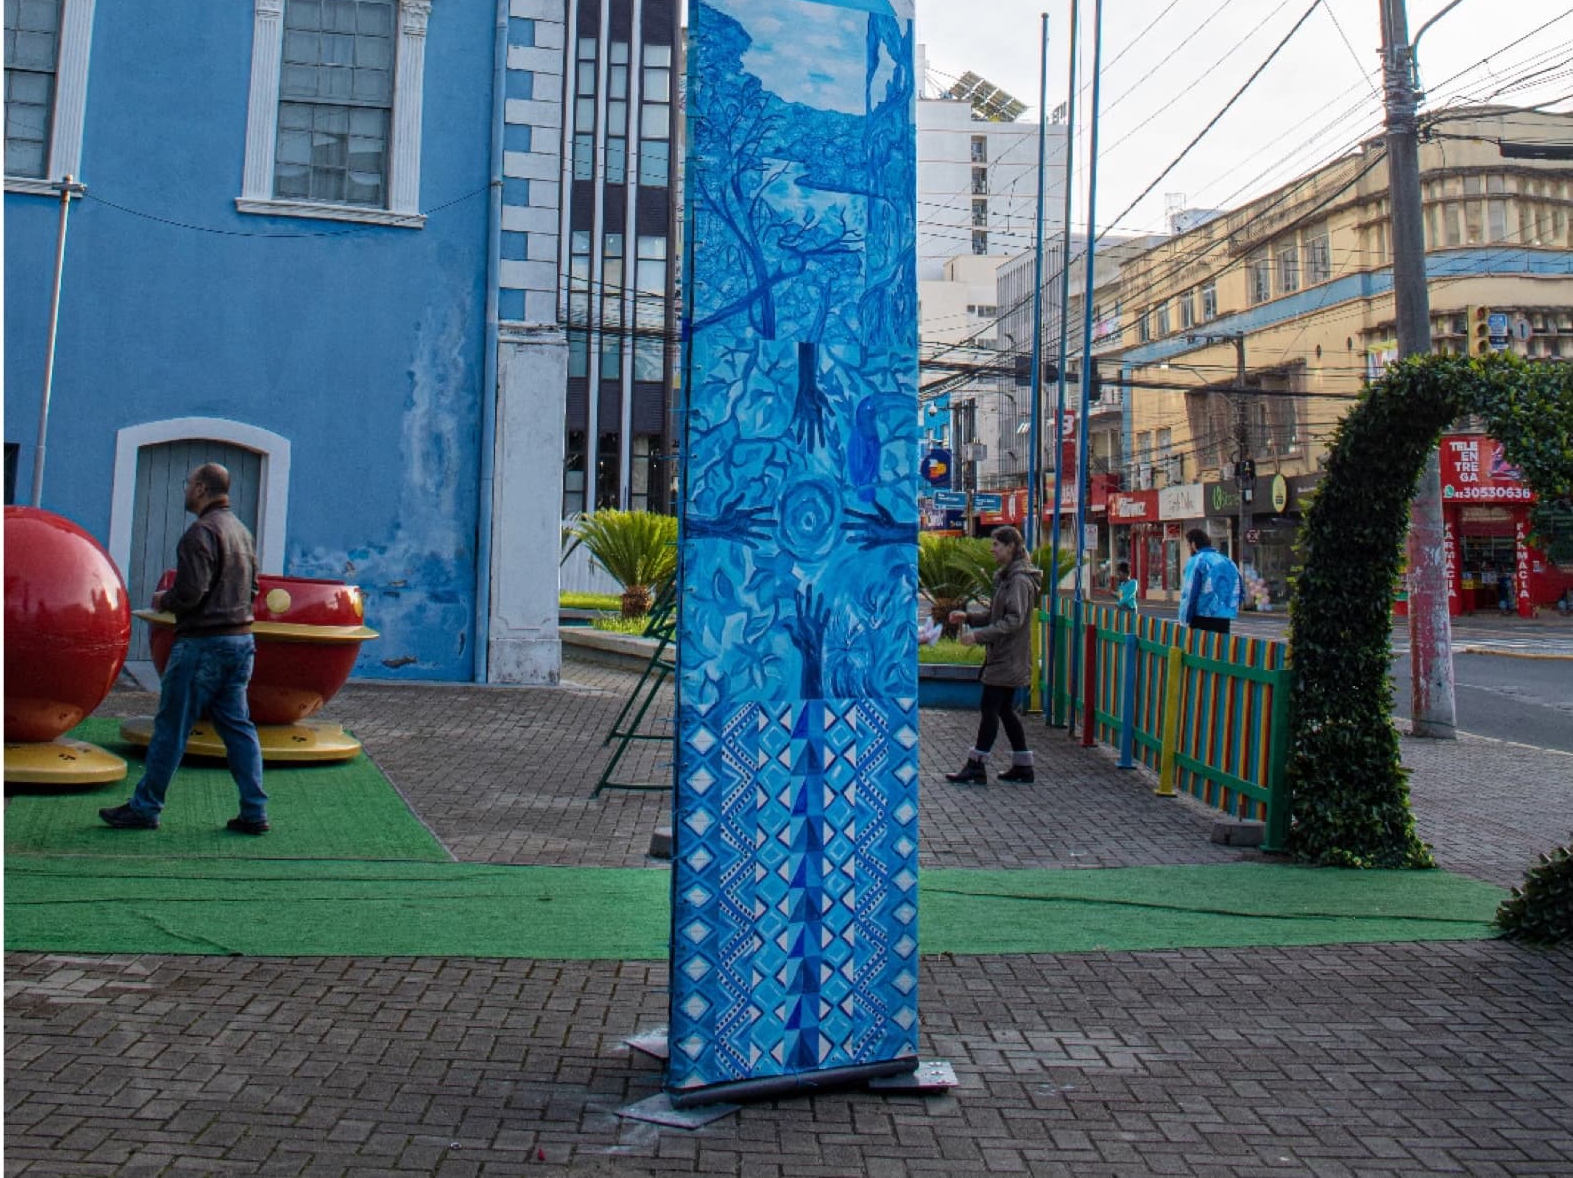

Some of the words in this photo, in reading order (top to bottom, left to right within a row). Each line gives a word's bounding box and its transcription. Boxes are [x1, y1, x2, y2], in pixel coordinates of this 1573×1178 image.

[1449, 441, 1478, 451] TELE
[1461, 451, 1478, 461] EN
[1455, 462, 1478, 472] TRE
[1460, 473, 1478, 482] GA
[1516, 522, 1530, 598] FARMACIA
